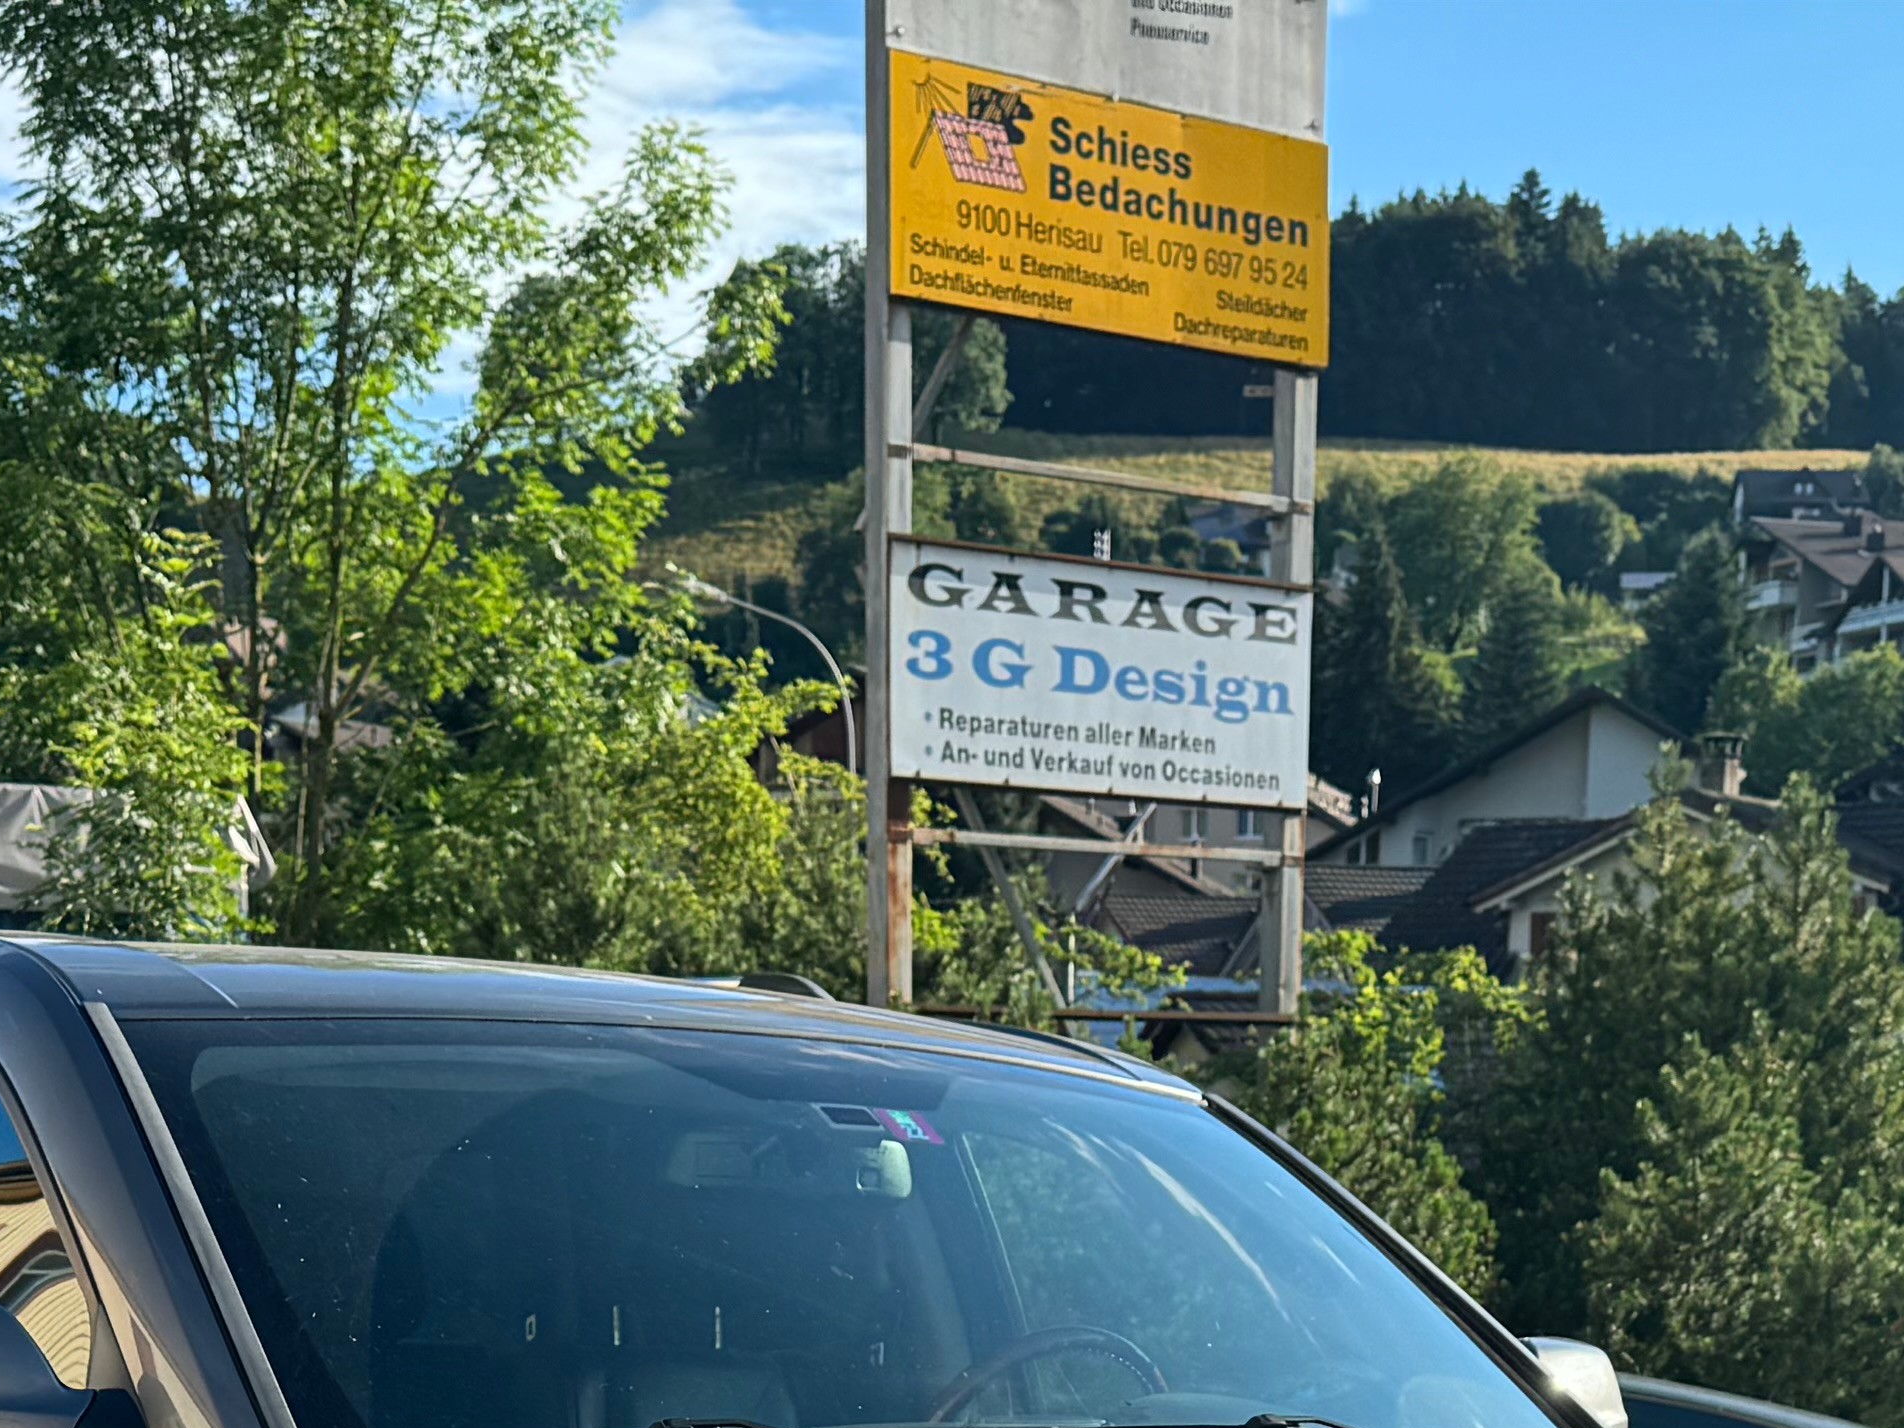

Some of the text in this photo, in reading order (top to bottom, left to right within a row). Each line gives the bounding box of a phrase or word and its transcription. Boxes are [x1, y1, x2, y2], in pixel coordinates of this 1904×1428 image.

[1049, 116, 1192, 180] Schiess
[1049, 163, 1308, 247] Bedachungen
[910, 233, 993, 266] Schindel-
[999, 255, 1015, 272] u.
[956, 199, 1308, 290] 9100 Herisau Tel. 079 697 95 24
[909, 264, 1072, 312] Dachflächenfenster
[1174, 312, 1308, 351] Dachreparaturen
[907, 563, 1297, 645] GARAGE
[1051, 644, 1295, 724] Design
[939, 707, 1216, 754] Reparaturen aller Marken
[941, 740, 1280, 790] An- und Verkauf von Occasionen
